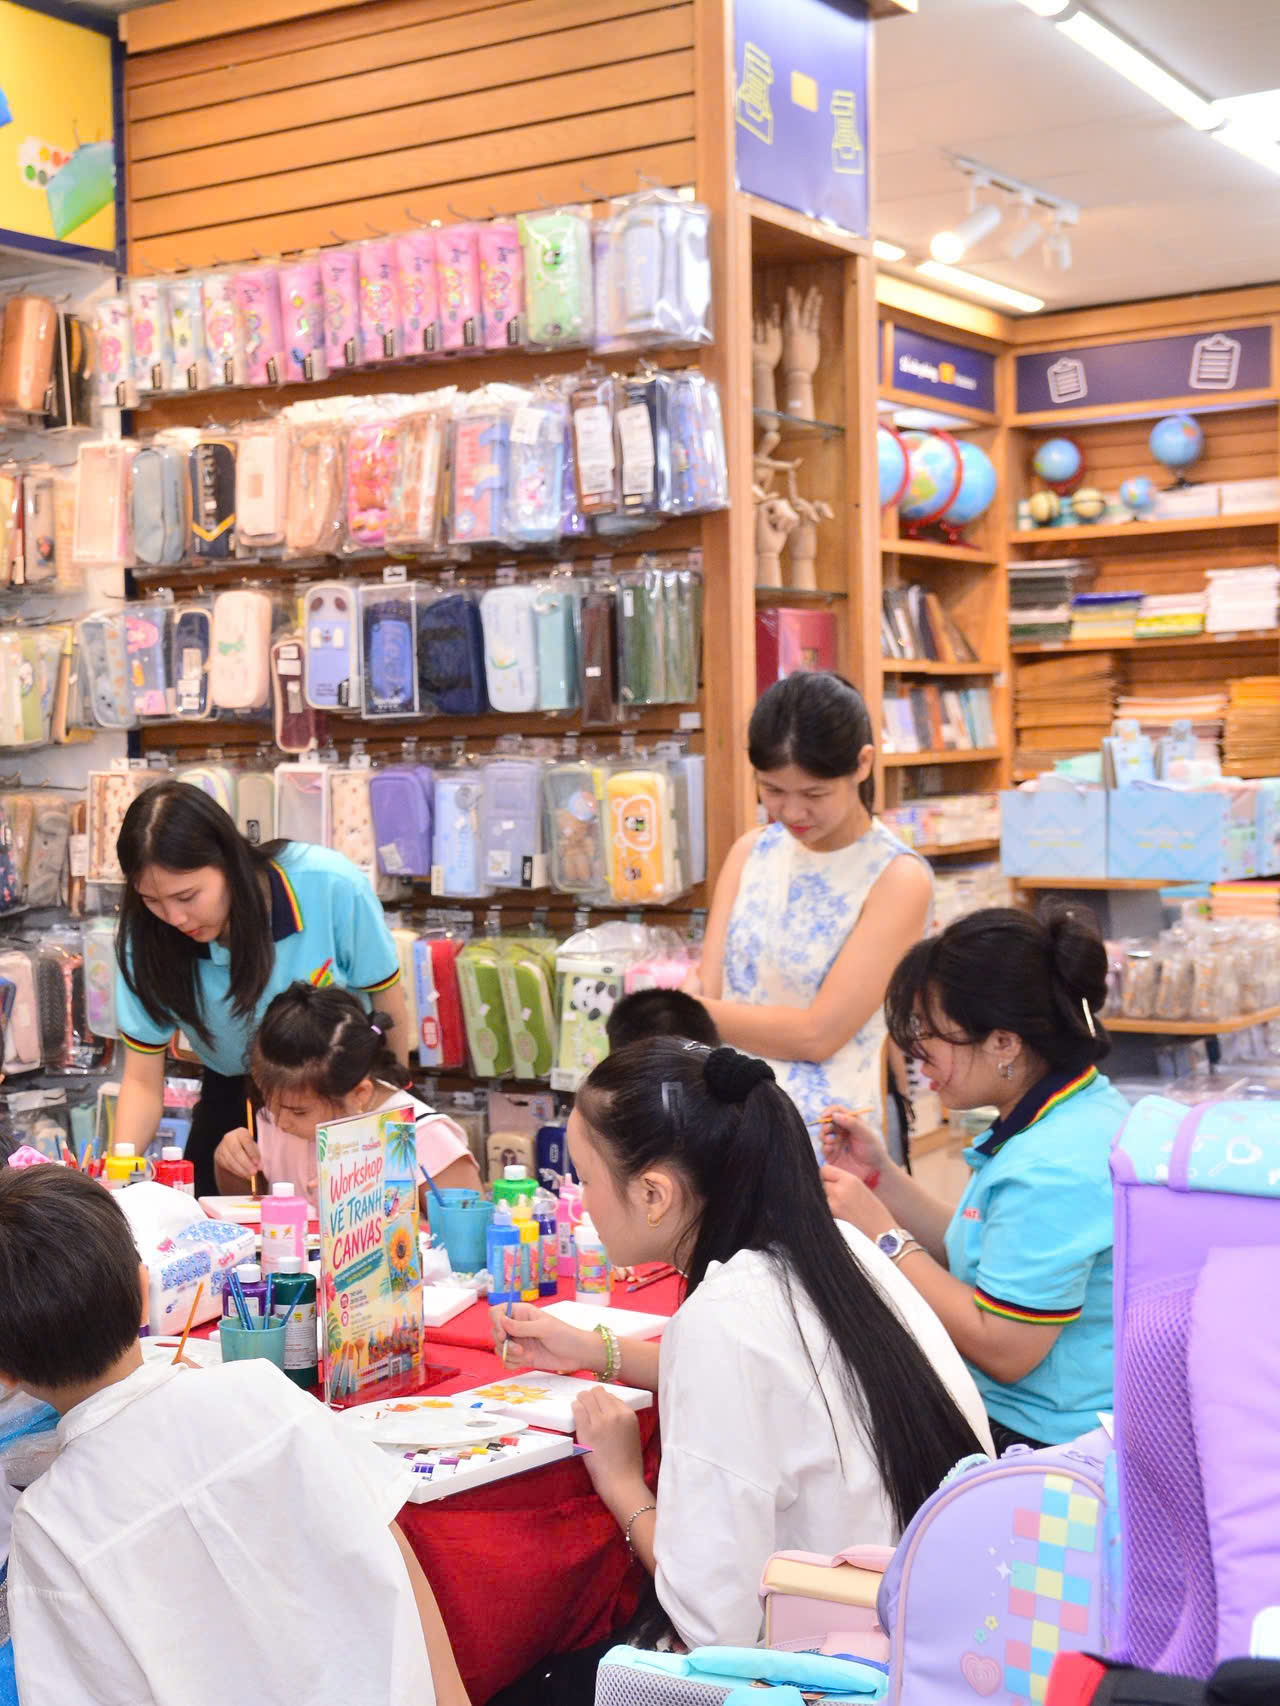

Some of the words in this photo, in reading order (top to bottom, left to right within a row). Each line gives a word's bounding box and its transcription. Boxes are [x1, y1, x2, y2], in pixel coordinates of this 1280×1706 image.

[330, 1156, 383, 1204] Workshop
[347, 1188, 382, 1226] TRANH
[332, 1217, 382, 1270] CANVAS
